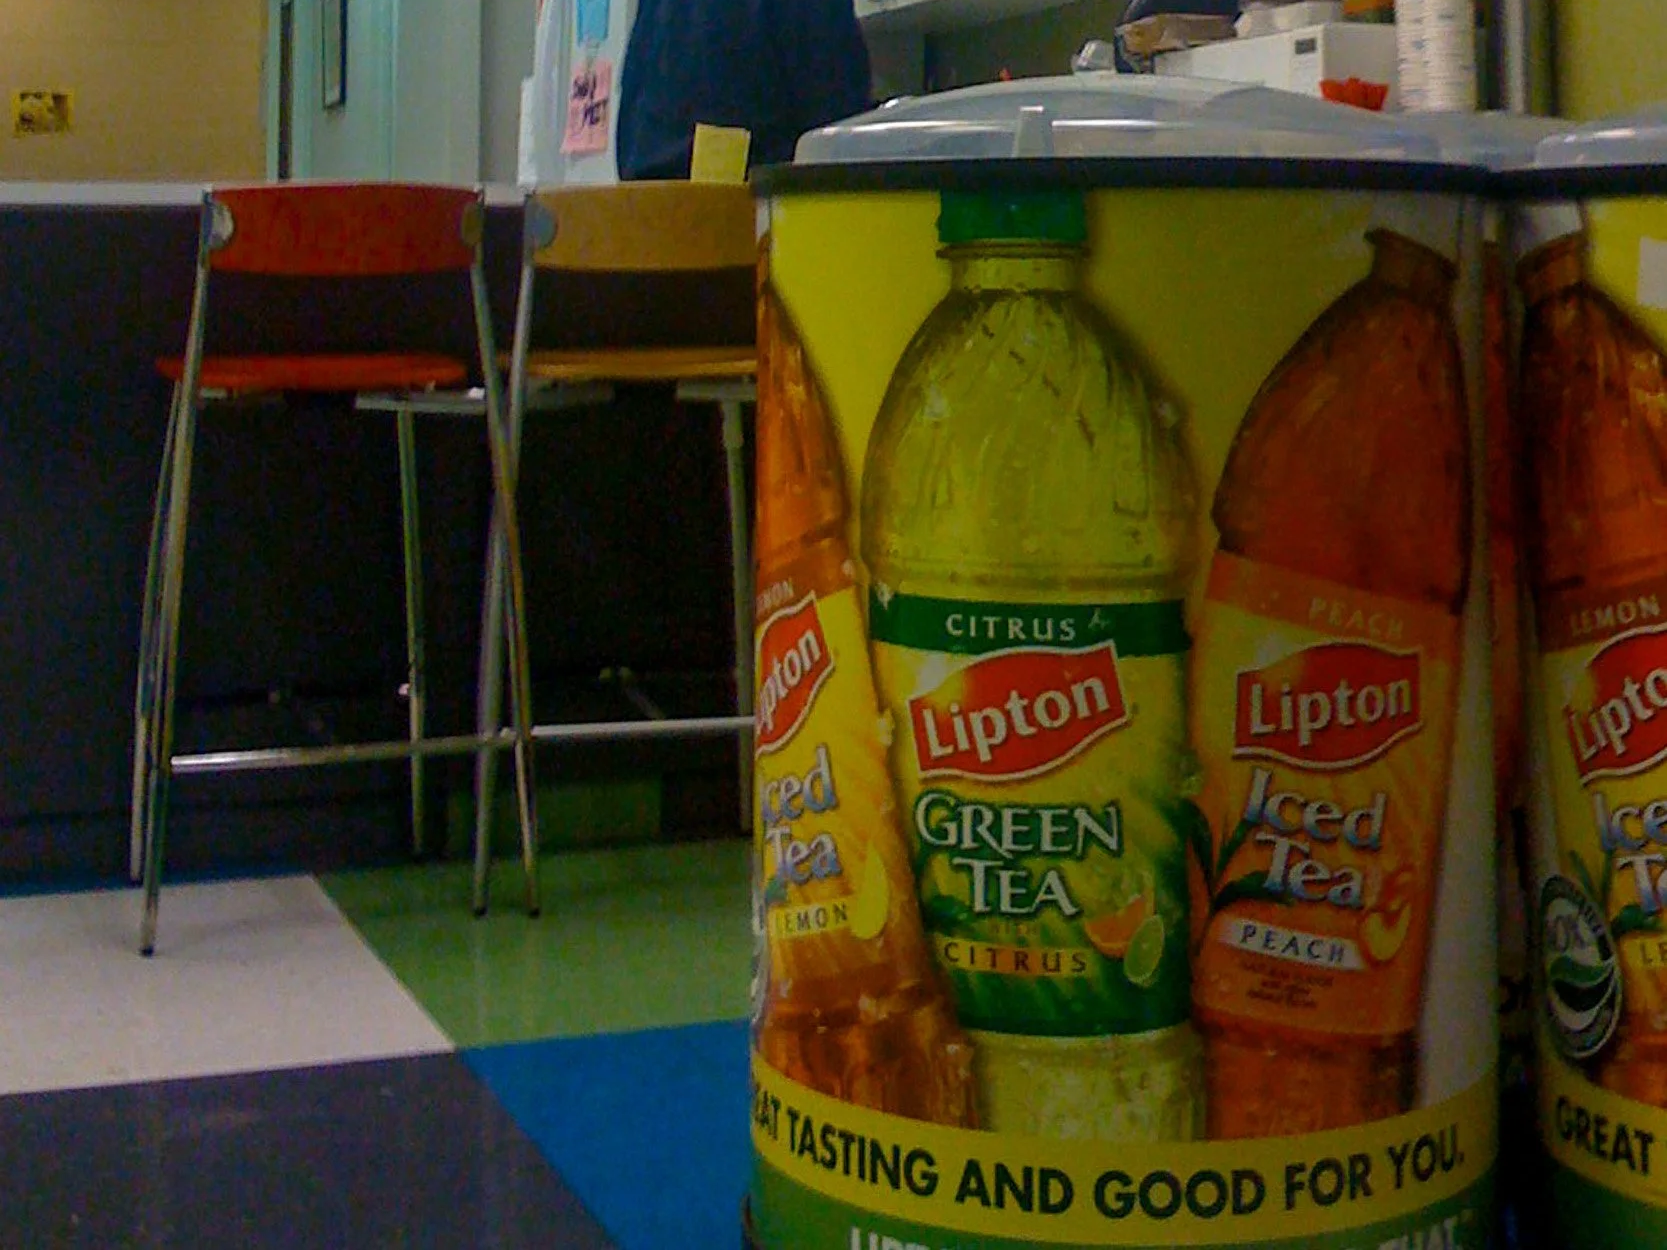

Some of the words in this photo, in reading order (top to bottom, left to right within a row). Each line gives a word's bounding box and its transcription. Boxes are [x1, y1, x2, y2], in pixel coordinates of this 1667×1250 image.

[945, 613, 1077, 642] CITRUS
[1309, 596, 1405, 639] PEACH
[1570, 594, 1660, 637] LEMON
[922, 672, 1111, 764] Lipton
[1249, 677, 1412, 748] Lipton
[914, 790, 1120, 860] GREEN
[1244, 767, 1387, 851] Iced
[765, 824, 842, 888] Tea
[951, 856, 1079, 917] TEA
[1256, 832, 1364, 909] Tea
[943, 941, 1088, 975] CITRUS
[1240, 923, 1346, 964] PEACH
[787, 1106, 939, 1196] TASTING
[955, 1159, 1074, 1214] AND
[1095, 1169, 1265, 1218] GOOD
[1285, 1153, 1373, 1210] FOR
[1387, 1122, 1466, 1190] YOU.
[1556, 1094, 1654, 1176] GREAT
